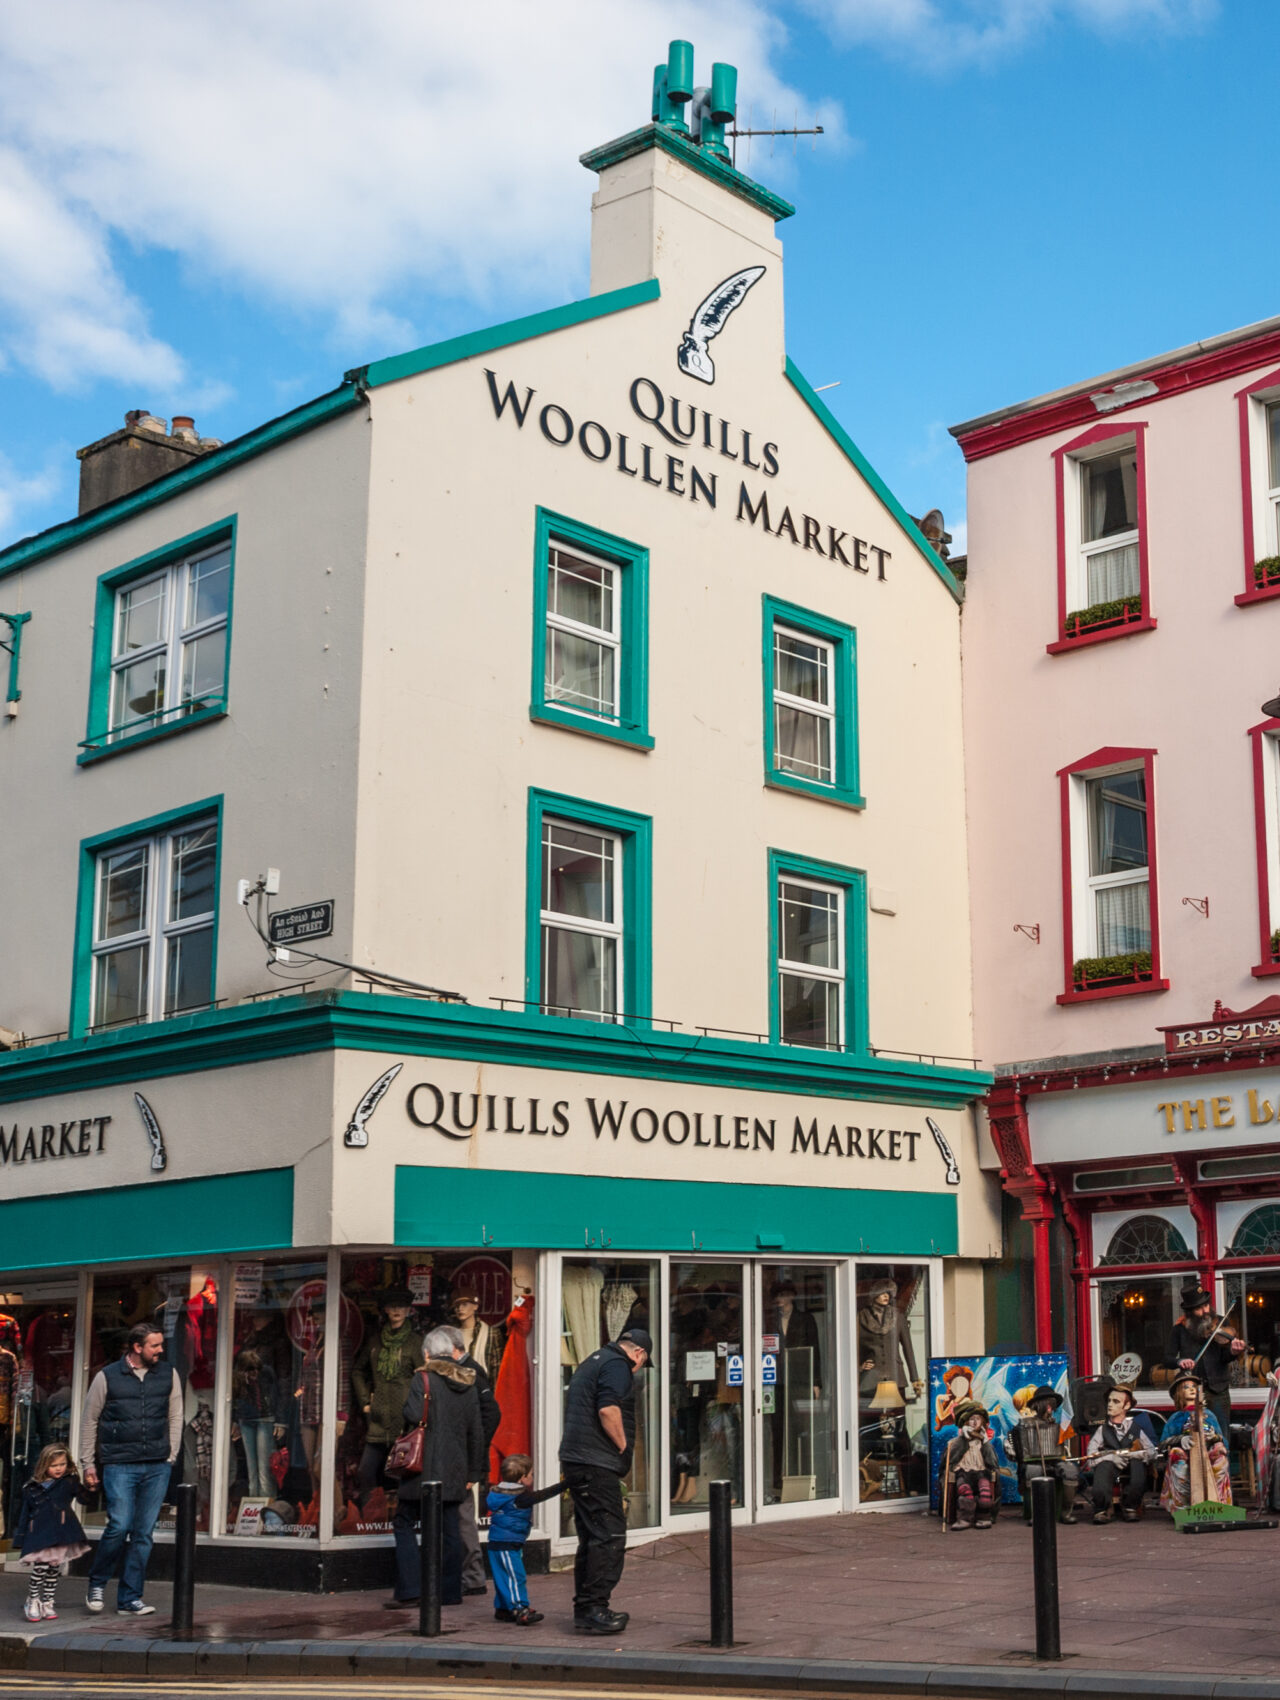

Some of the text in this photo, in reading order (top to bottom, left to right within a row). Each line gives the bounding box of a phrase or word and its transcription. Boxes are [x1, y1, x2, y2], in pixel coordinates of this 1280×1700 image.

[629, 377, 781, 478] QUILLS
[484, 368, 892, 582] WOOLLEN MARKET
[277, 920, 323, 939] HIGH STREET
[406, 1082, 921, 1162] QUILLS WOOLLEN MARKET
[1157, 1095, 1236, 1133] THE
[0, 1116, 113, 1164] MARKET
[1113, 1363, 1141, 1373] PIZZA
[1186, 1506, 1224, 1517] THANK
